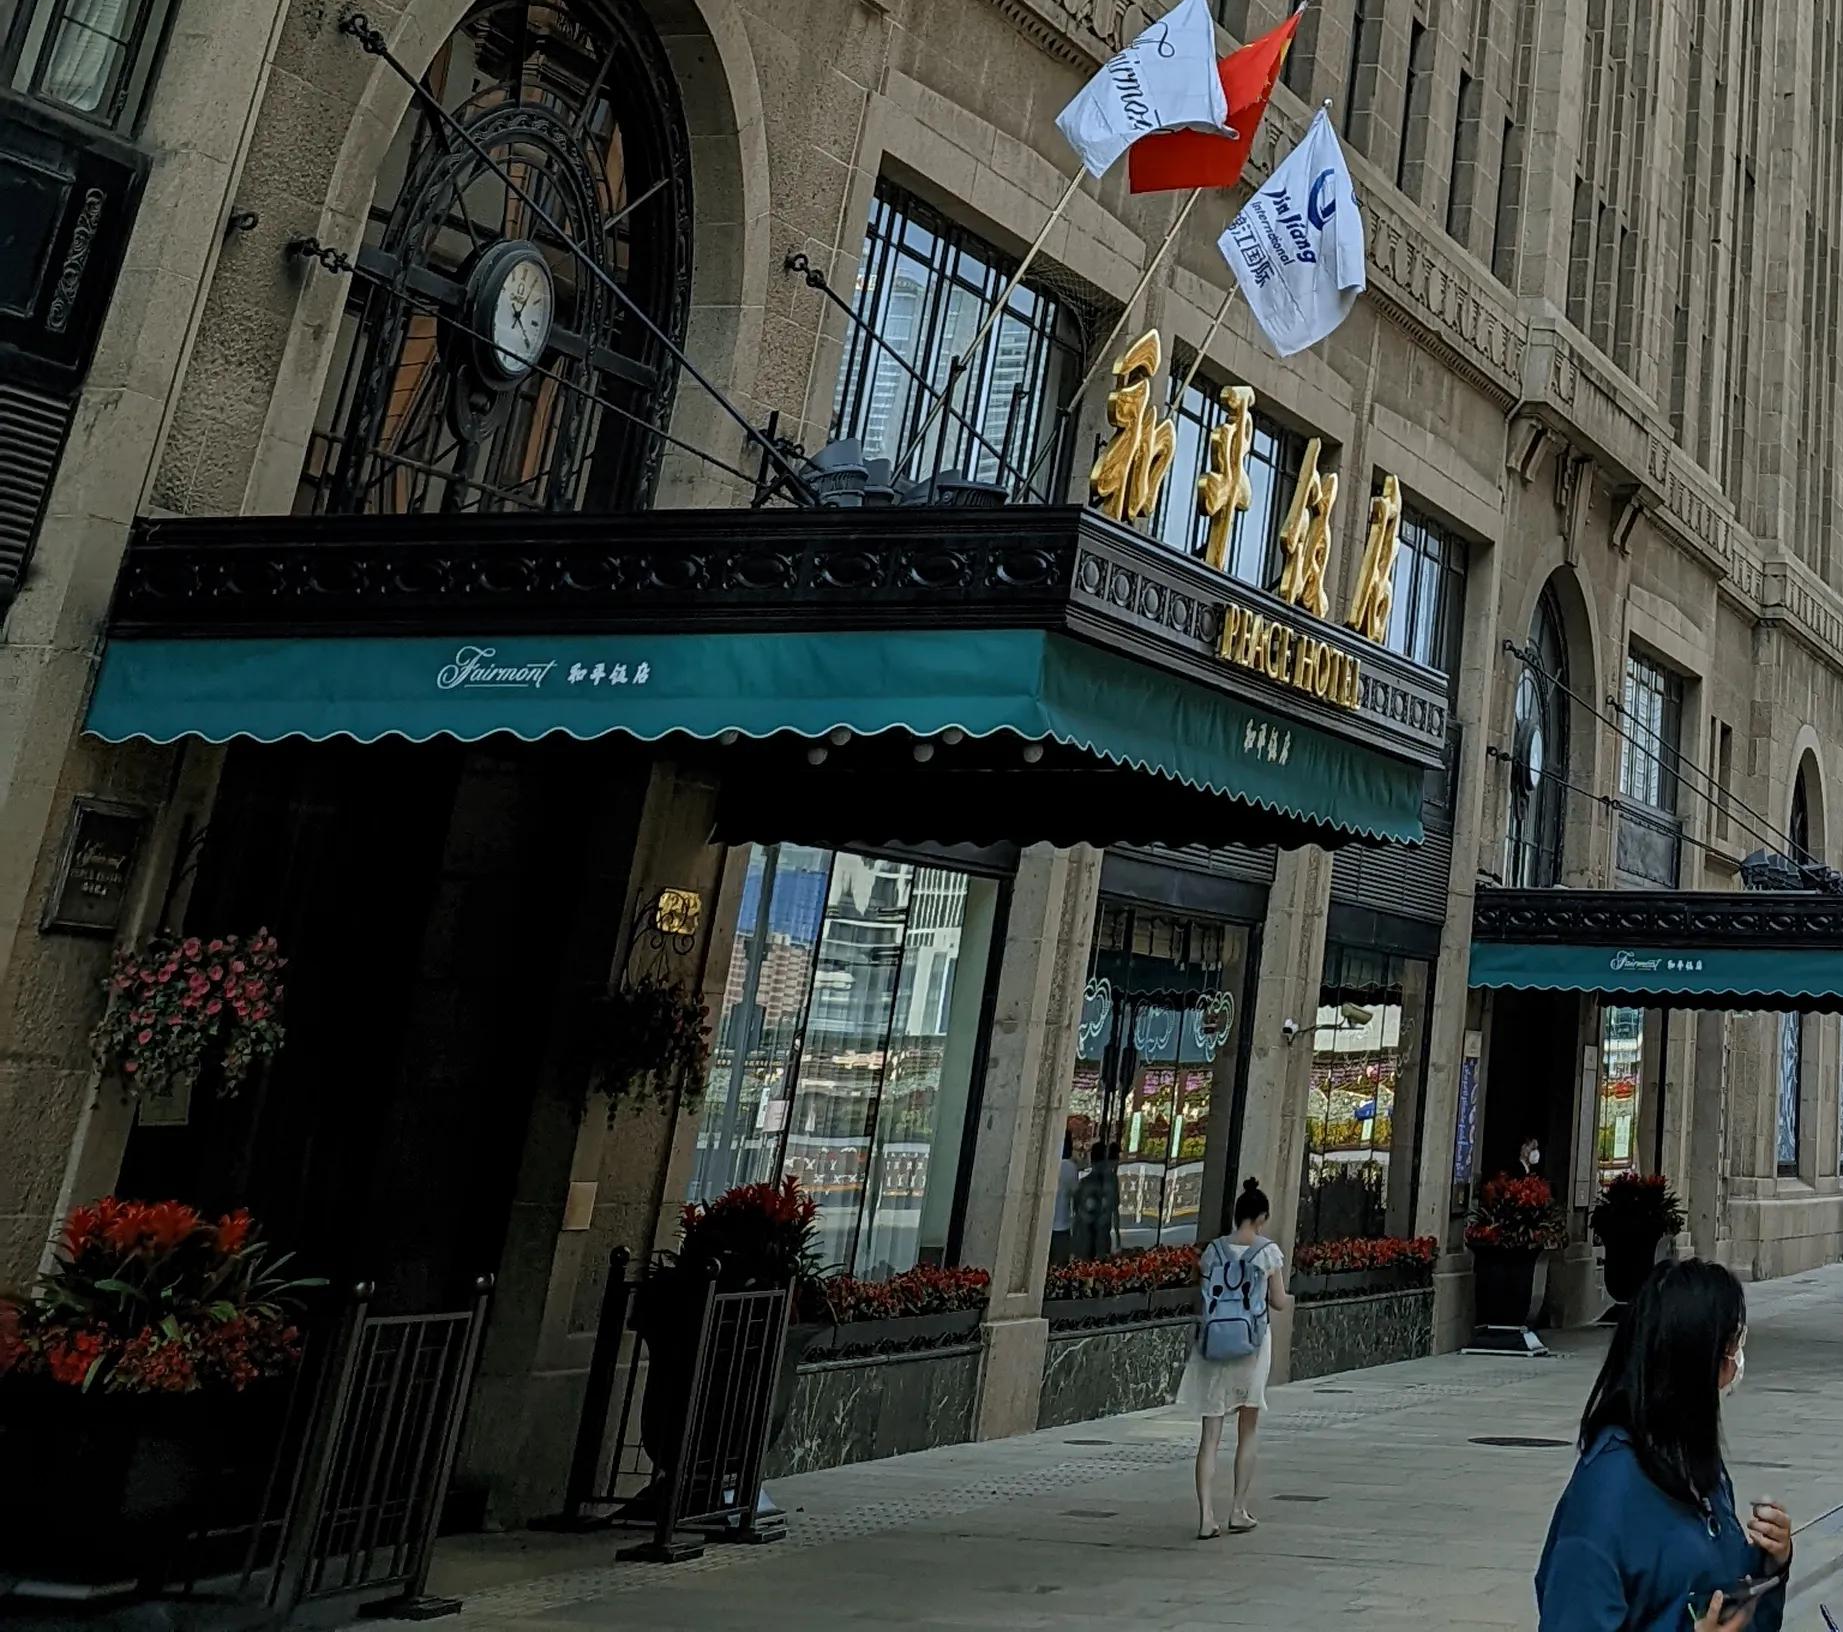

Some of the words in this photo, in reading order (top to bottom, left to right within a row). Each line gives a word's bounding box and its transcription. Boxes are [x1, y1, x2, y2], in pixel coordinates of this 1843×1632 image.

[436, 645, 558, 690] Fairmont
[1217, 602, 1296, 683] PEACE
[1293, 635, 1362, 711] HOTEL
